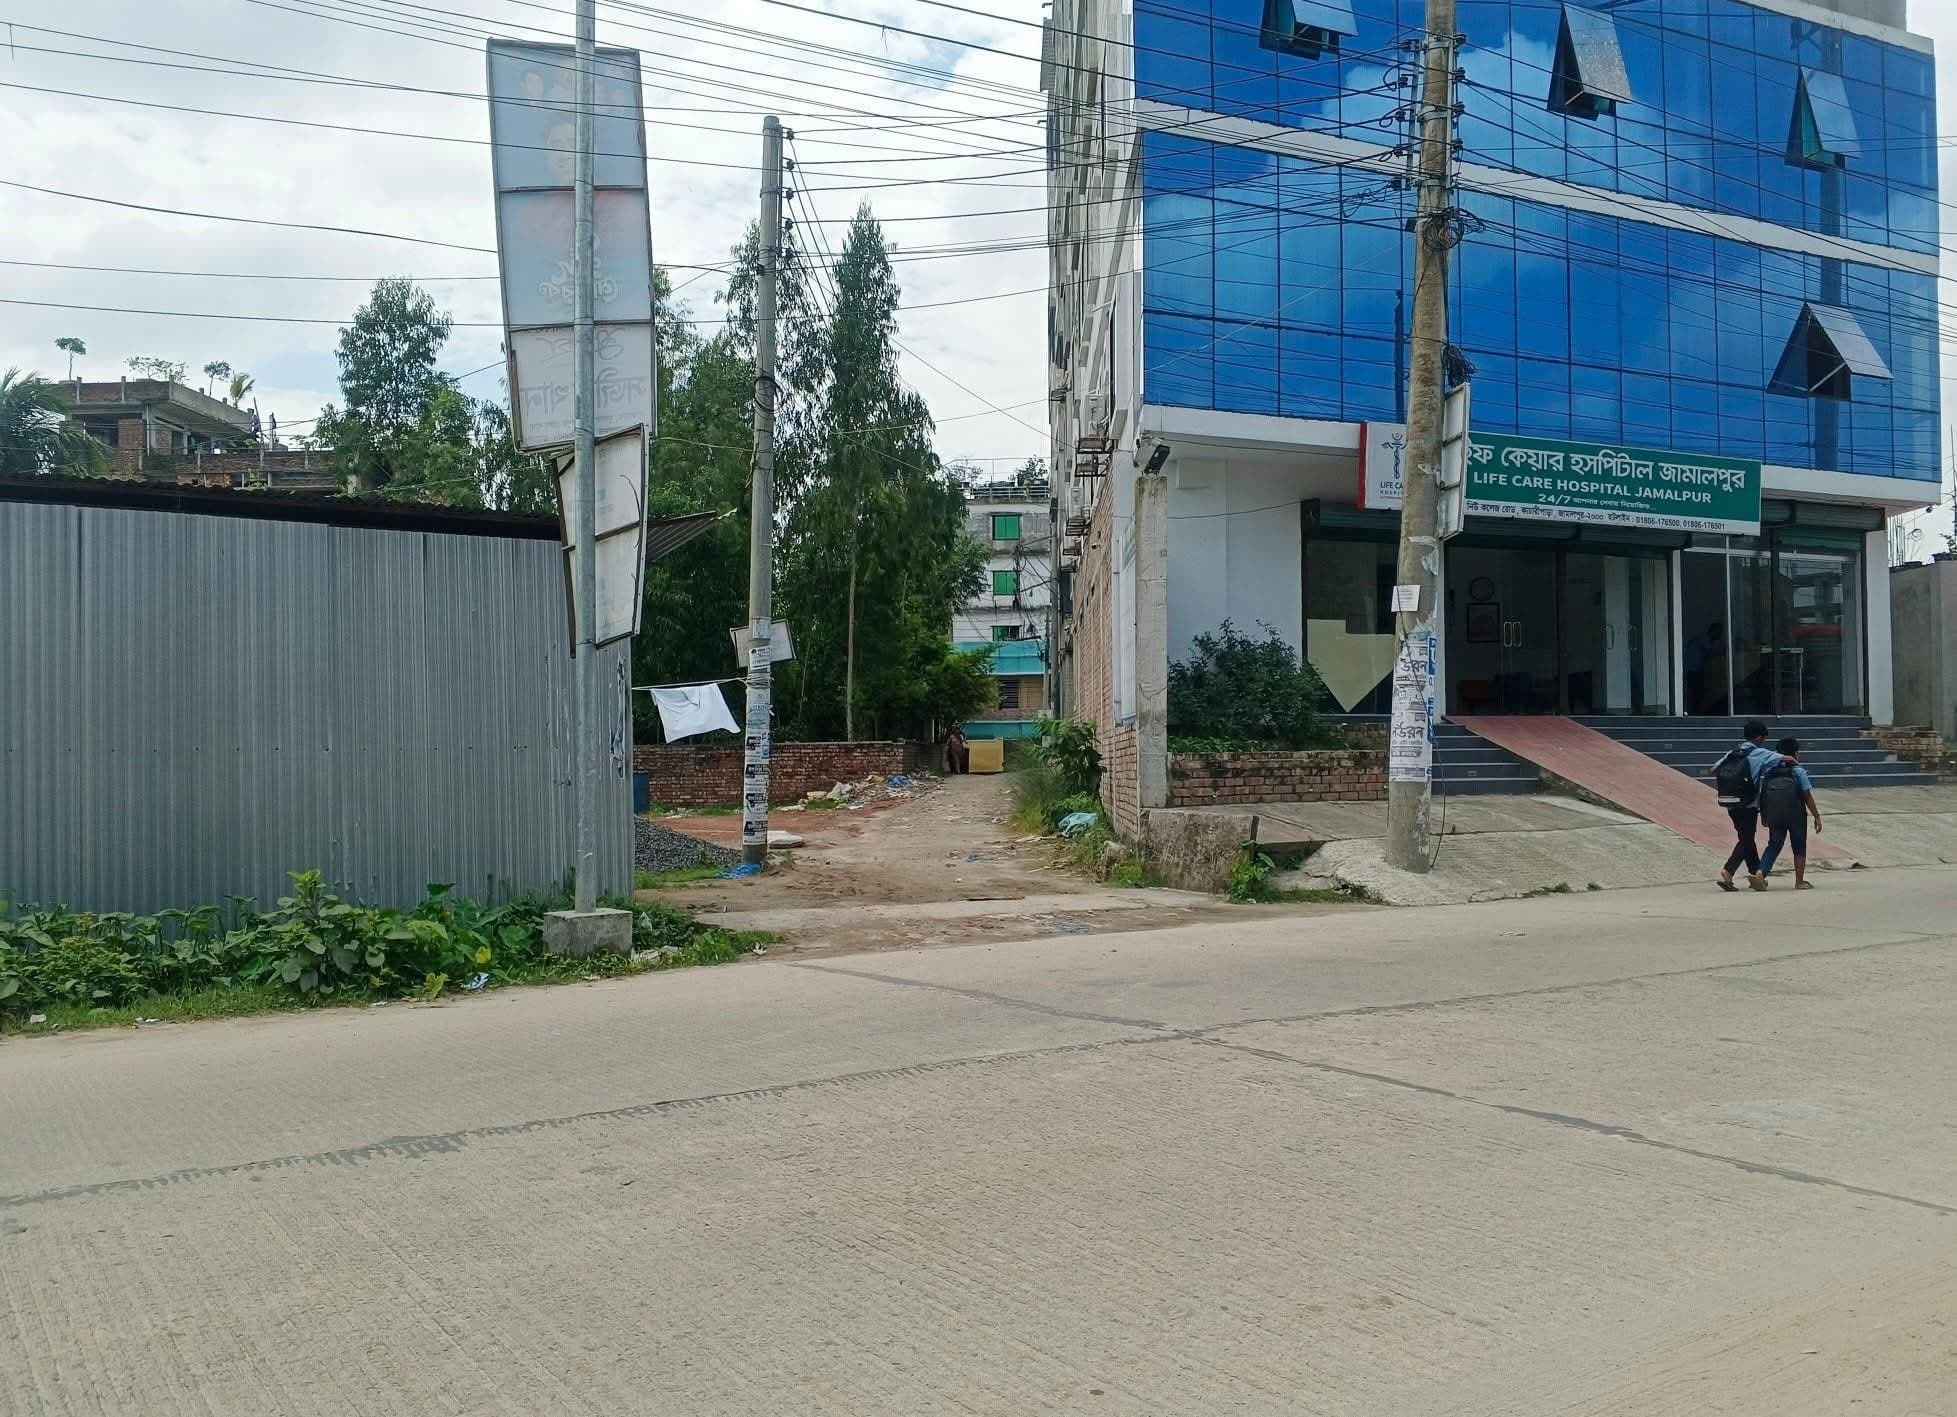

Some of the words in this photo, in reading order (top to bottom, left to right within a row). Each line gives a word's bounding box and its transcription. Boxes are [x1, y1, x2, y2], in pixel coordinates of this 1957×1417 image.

[1466, 439, 1495, 465] ইফ
[1501, 447, 1565, 472] কেয়ার
[1569, 449, 1654, 480] হসপিটাল
[1658, 463, 1745, 492] জামালপুর
[1380, 481, 1393, 489] LIFE
[1473, 472, 1508, 485] LIFE
[1512, 475, 1553, 489] CARE
[1557, 479, 1631, 496] HOSPITAL
[1635, 487, 1712, 503] JAMALPUR
[1537, 494, 1571, 505] 24/7
